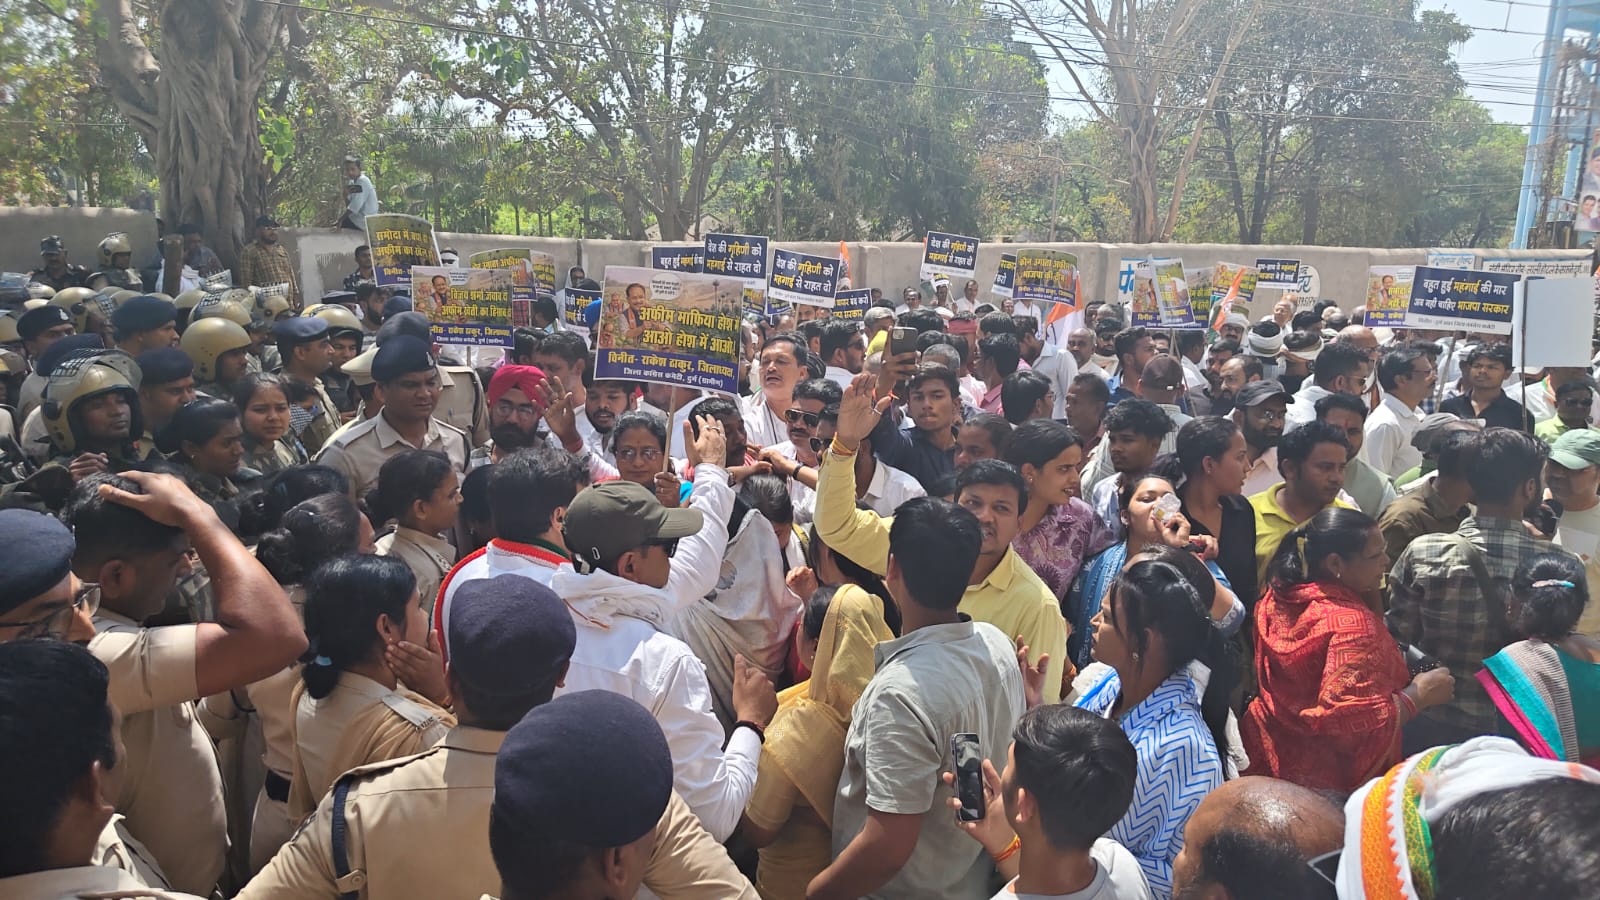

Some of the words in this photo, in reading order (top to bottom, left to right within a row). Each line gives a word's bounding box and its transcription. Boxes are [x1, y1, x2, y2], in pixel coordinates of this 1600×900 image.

[708, 240, 717, 252] देश
[718, 240, 726, 254] की
[728, 241, 750, 258] गृहिणी
[752, 243, 762, 257] को
[931, 236, 941, 248] देश
[942, 238, 950, 249] की
[966, 243, 974, 254] को
[706, 256, 726, 272] महंगाई
[726, 258, 734, 271] से
[734, 262, 751, 274] राहत
[753, 260, 762, 274] दो
[776, 255, 786, 269] देश
[787, 258, 797, 271] की
[798, 260, 822, 276] गृहिणी
[822, 264, 834, 276] को
[774, 272, 796, 288] महंगाई
[796, 276, 802, 288] से
[804, 280, 821, 292] राहत
[823, 280, 832, 292] दो
[1424, 279, 1440, 295] बहुत
[1441, 277, 1455, 294] हुई
[1454, 278, 1481, 294] महंगाई
[1480, 280, 1492, 295] की
[1493, 285, 1508, 296] मार
[1414, 298, 1424, 306] अब
[1438, 298, 1456, 312] चाहिए
[1457, 300, 1482, 312] भाजपा
[1482, 302, 1510, 315] सरकार
[640, 304, 676, 323] अफीम
[677, 309, 716, 329] माफिया
[716, 312, 733, 331] होश
[643, 327, 673, 348] आओ
[676, 330, 698, 349] होश
[698, 332, 707, 350] में
[641, 354, 668, 367] राकेश
[669, 358, 694, 374] ठाकुर,
